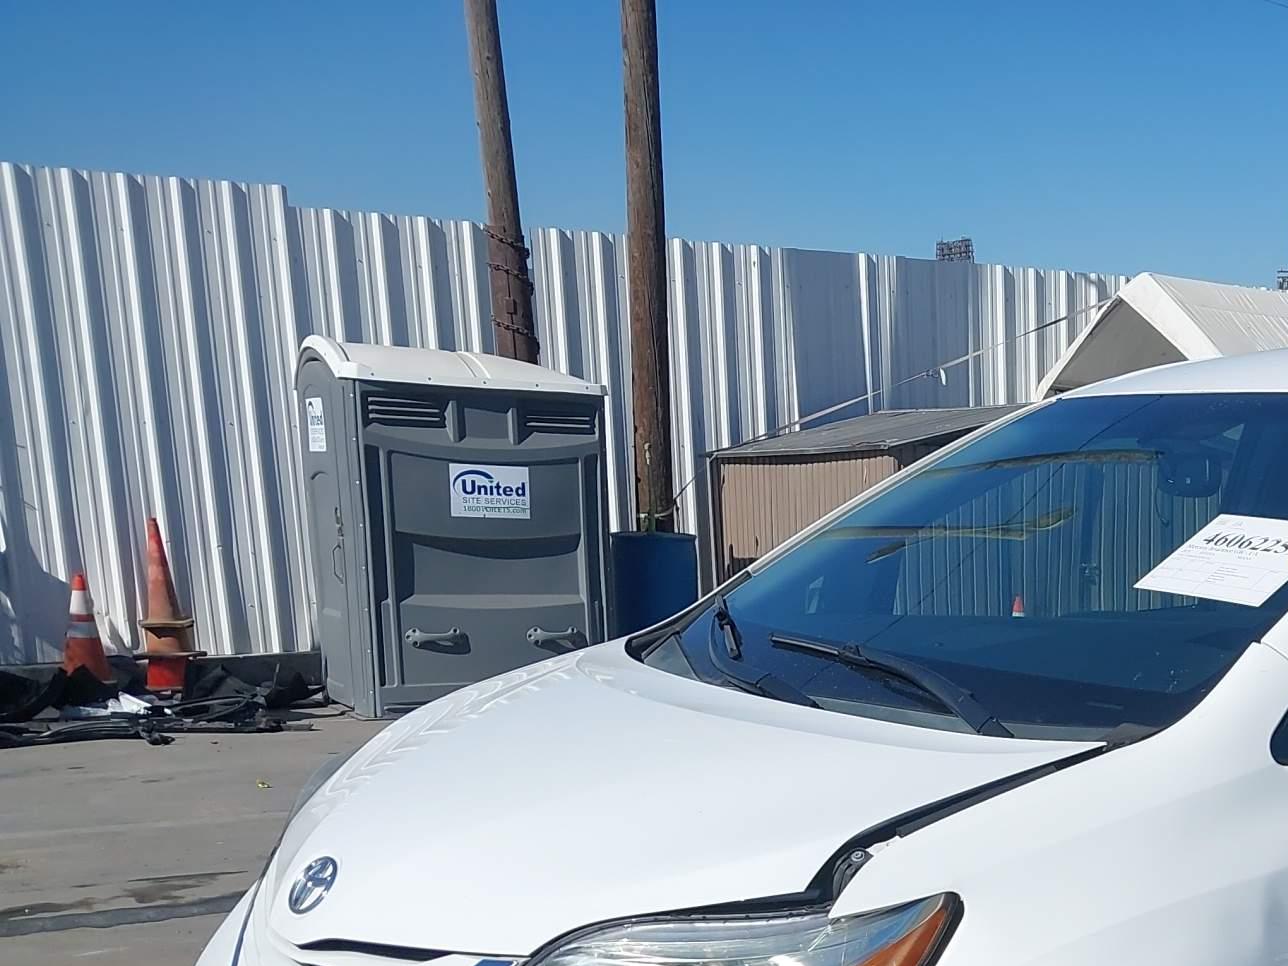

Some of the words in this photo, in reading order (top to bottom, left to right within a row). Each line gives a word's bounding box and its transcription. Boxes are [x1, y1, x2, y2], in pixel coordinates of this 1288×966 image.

[461, 478, 526, 497] United
[462, 496, 482, 505] SITE
[484, 497, 527, 506] SERVICES
